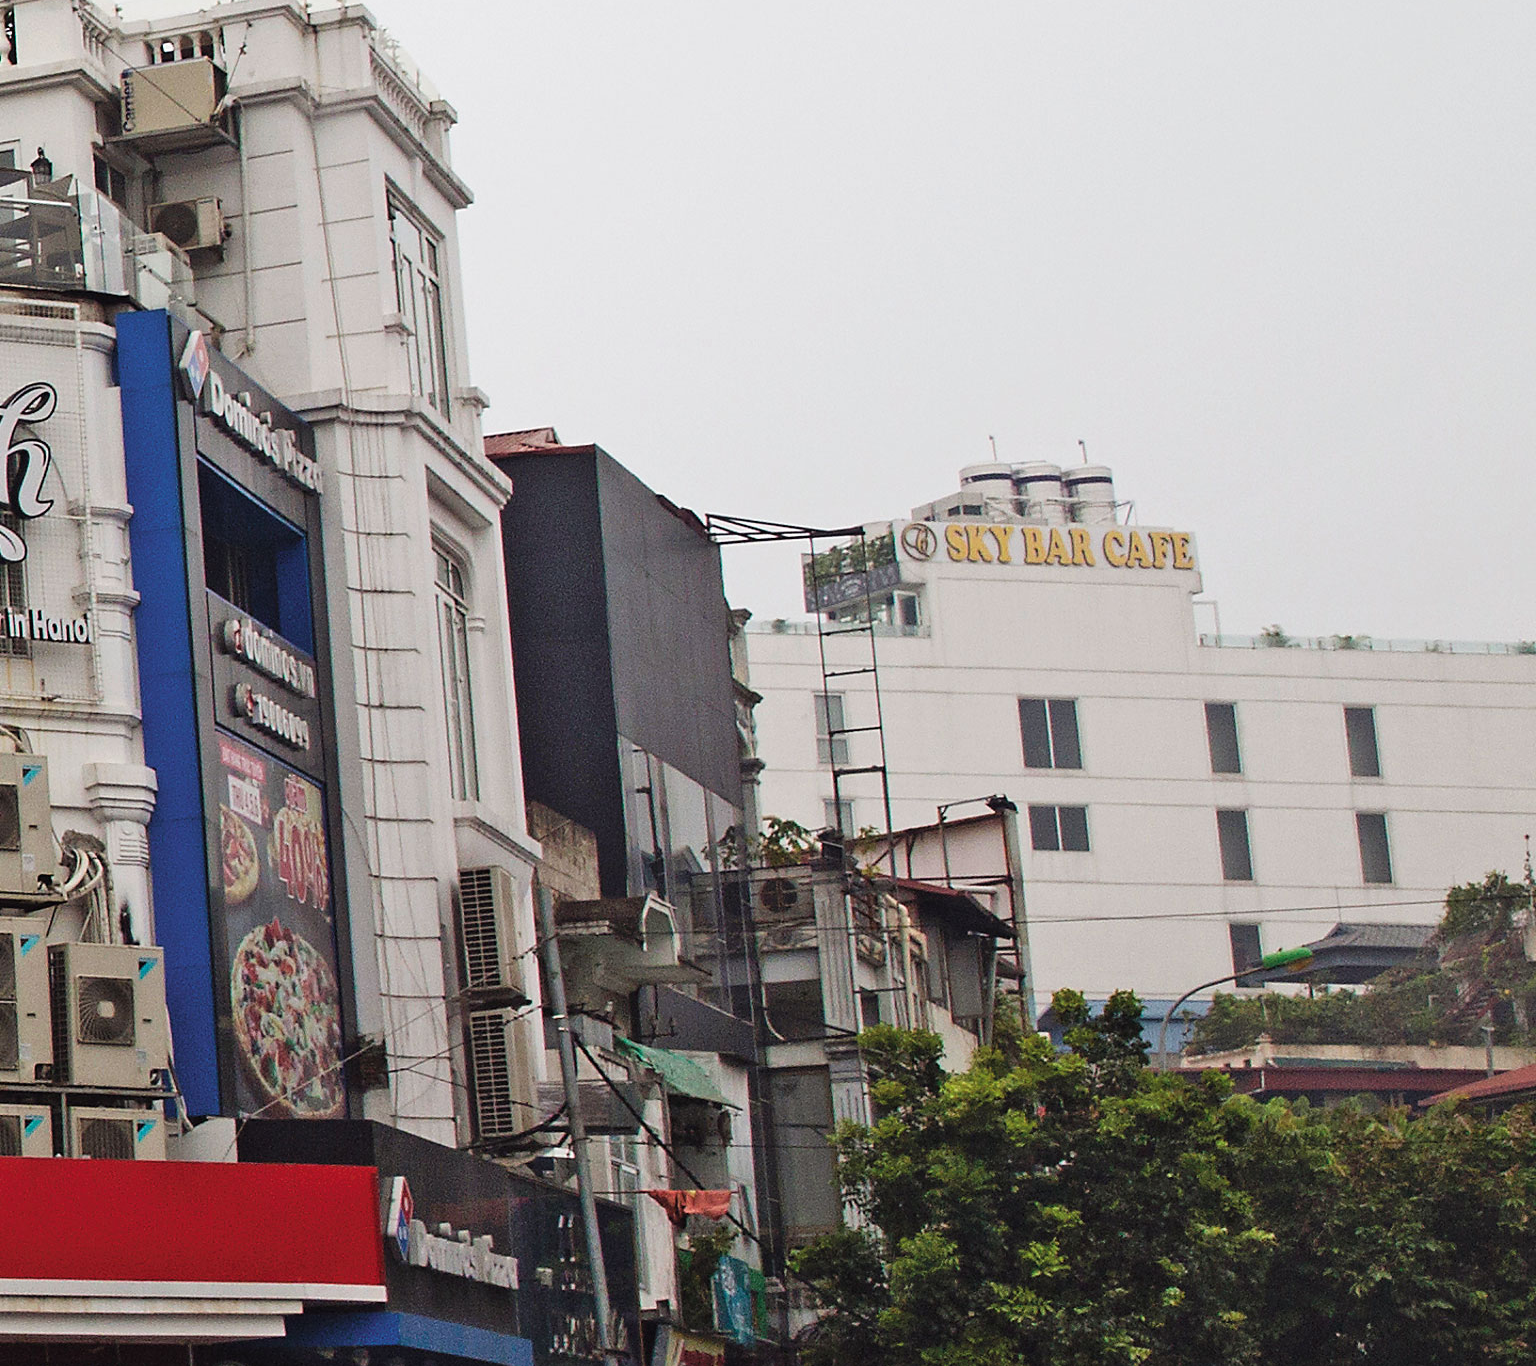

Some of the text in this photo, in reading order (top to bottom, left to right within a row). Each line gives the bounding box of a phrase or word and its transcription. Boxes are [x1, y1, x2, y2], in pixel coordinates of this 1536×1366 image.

[944, 524, 1195, 571] SKY BAR CAFE
[7, 606, 29, 640] in
[30, 608, 95, 646] Hanoi
